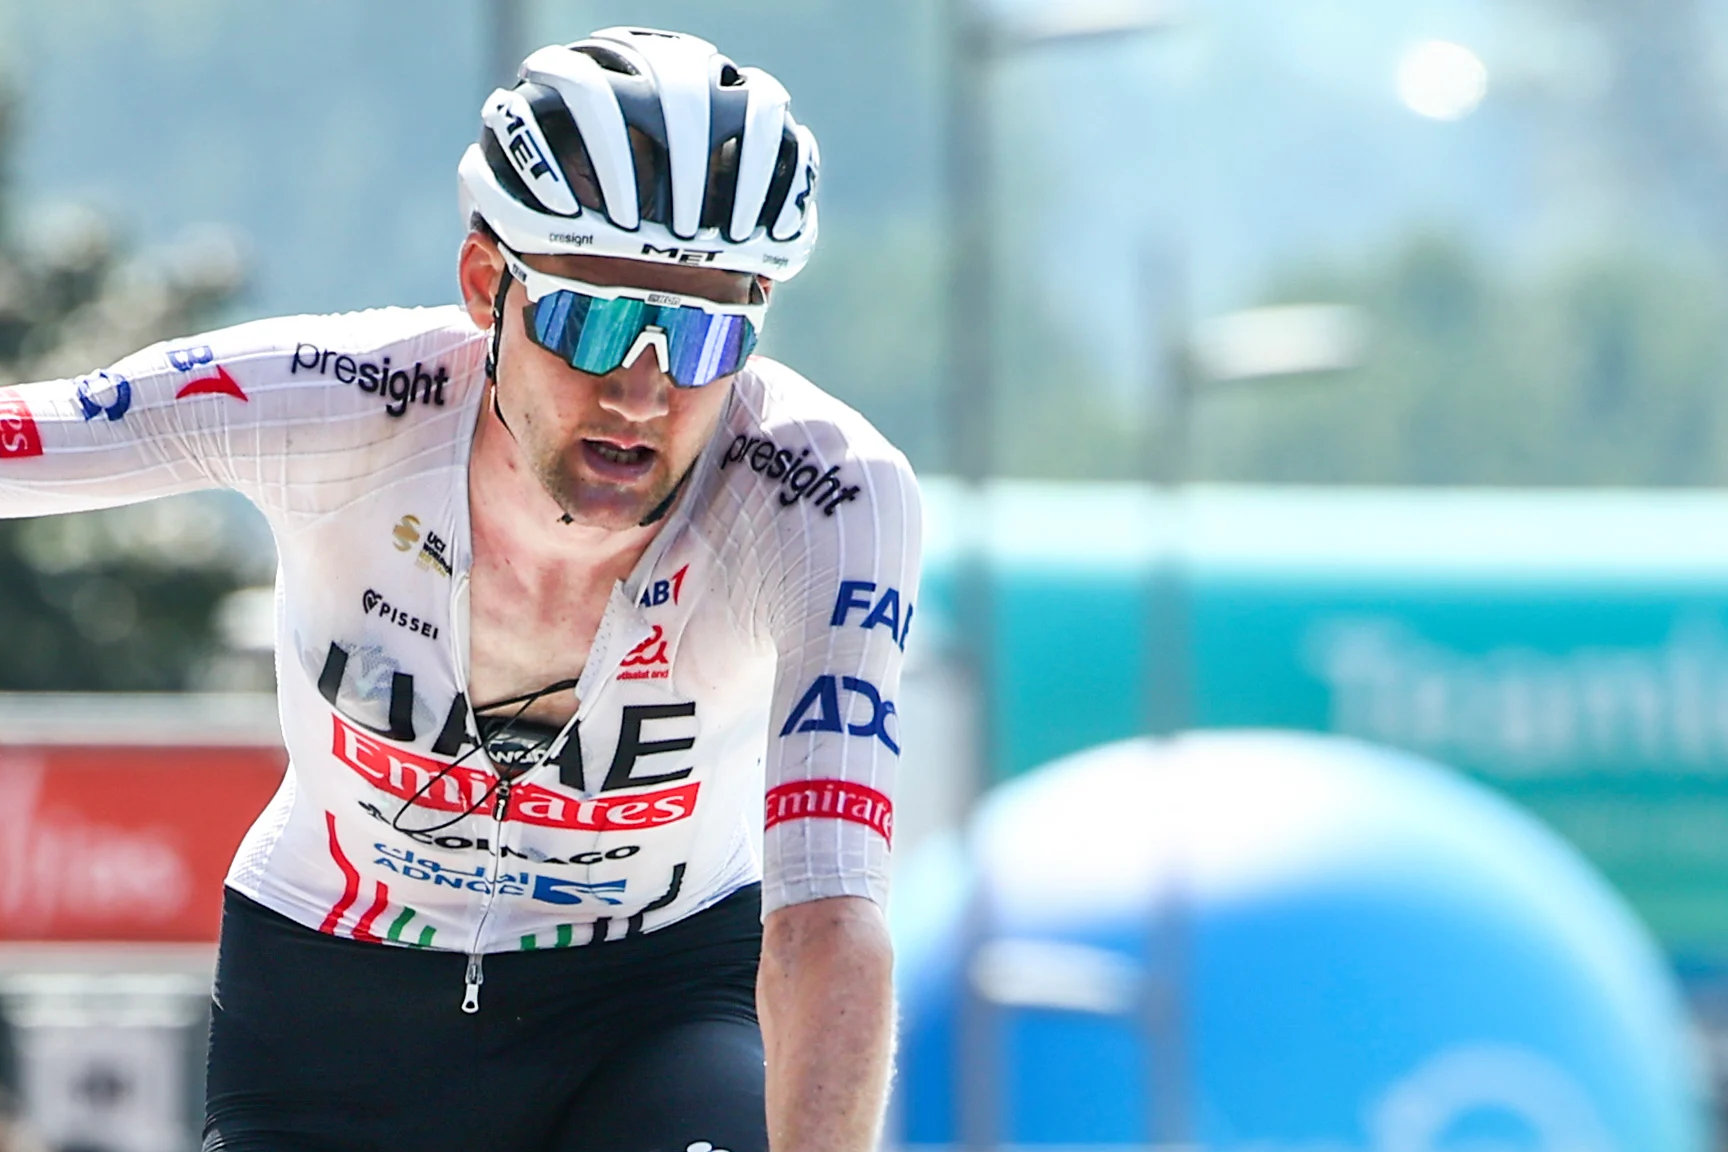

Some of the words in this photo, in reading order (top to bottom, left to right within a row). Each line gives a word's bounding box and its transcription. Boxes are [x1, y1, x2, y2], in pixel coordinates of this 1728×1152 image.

[495, 100, 559, 182] MET
[641, 243, 725, 267] MET
[291, 342, 448, 417] presight
[721, 433, 859, 516] presight
[427, 530, 446, 554] UCI
[378, 602, 438, 640] PISSEI
[639, 579, 670, 608] AB
[317, 640, 696, 793] UAE
[340, 724, 688, 827] Emiates
[374, 857, 525, 896] ADNOC
